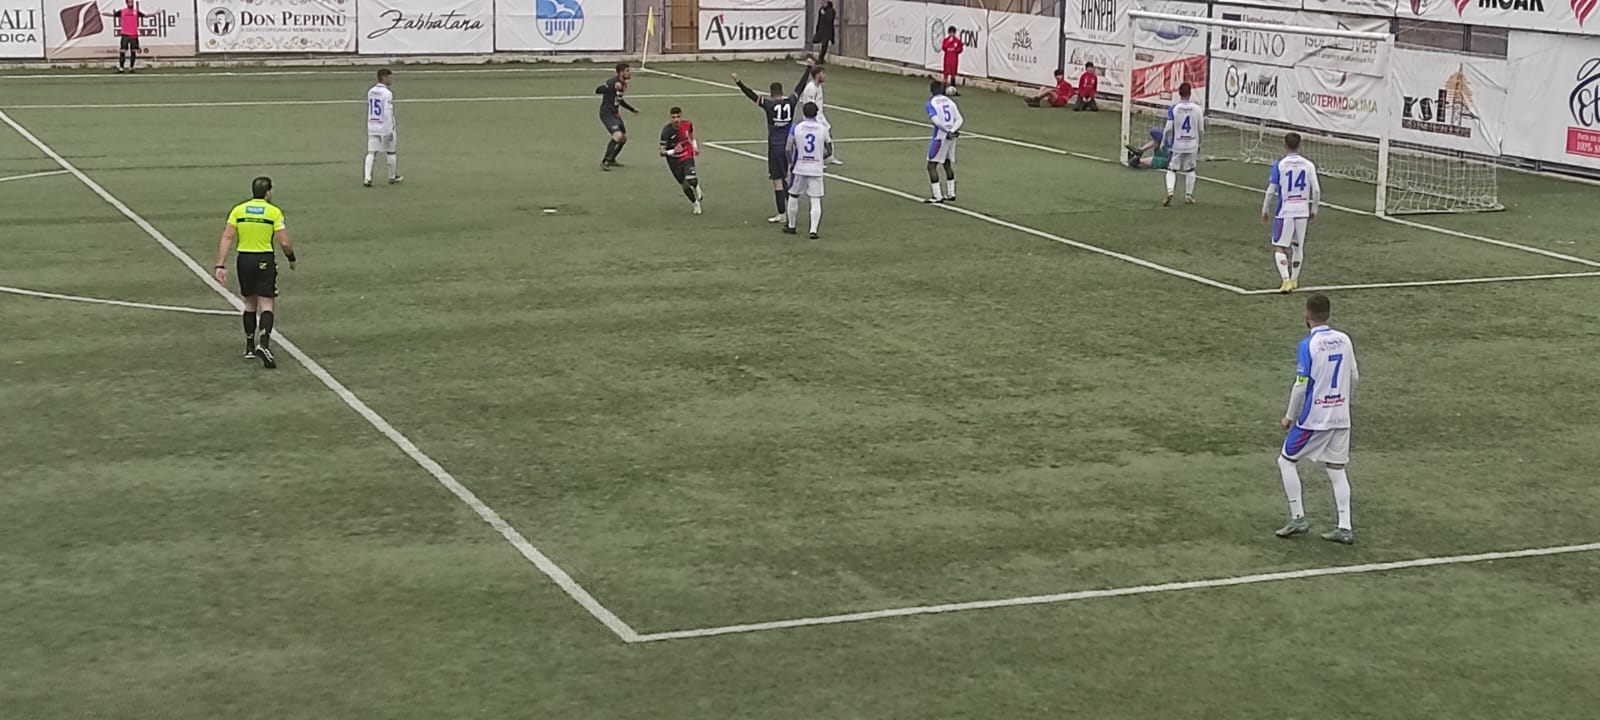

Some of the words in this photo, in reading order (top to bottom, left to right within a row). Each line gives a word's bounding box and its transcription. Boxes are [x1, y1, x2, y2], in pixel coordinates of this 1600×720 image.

[240, 11, 276, 26] DON
[369, 98, 382, 116] 15
[773, 103, 792, 121] 11
[942, 104, 952, 122] 5
[1181, 115, 1192, 133] 4
[804, 133, 816, 154] 3
[1285, 169, 1307, 192] 14
[1328, 353, 1343, 389] 7
